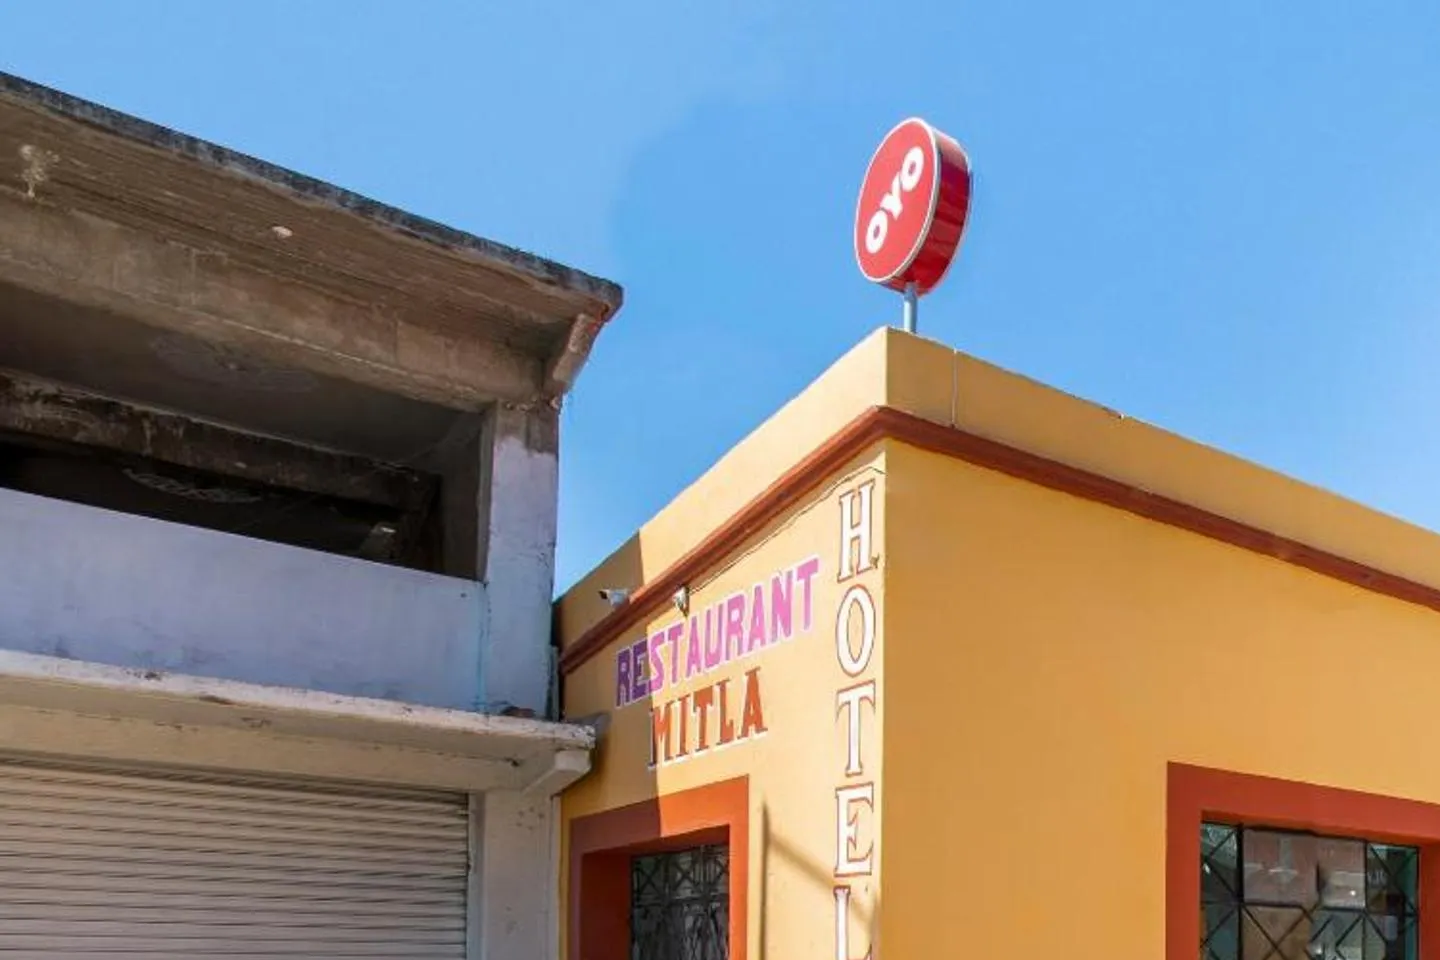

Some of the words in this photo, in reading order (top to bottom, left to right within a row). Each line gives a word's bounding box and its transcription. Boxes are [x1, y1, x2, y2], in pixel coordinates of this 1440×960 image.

[864, 145, 925, 255] OYO
[615, 556, 820, 709] RESTAURANT
[647, 665, 769, 769] MITLA
